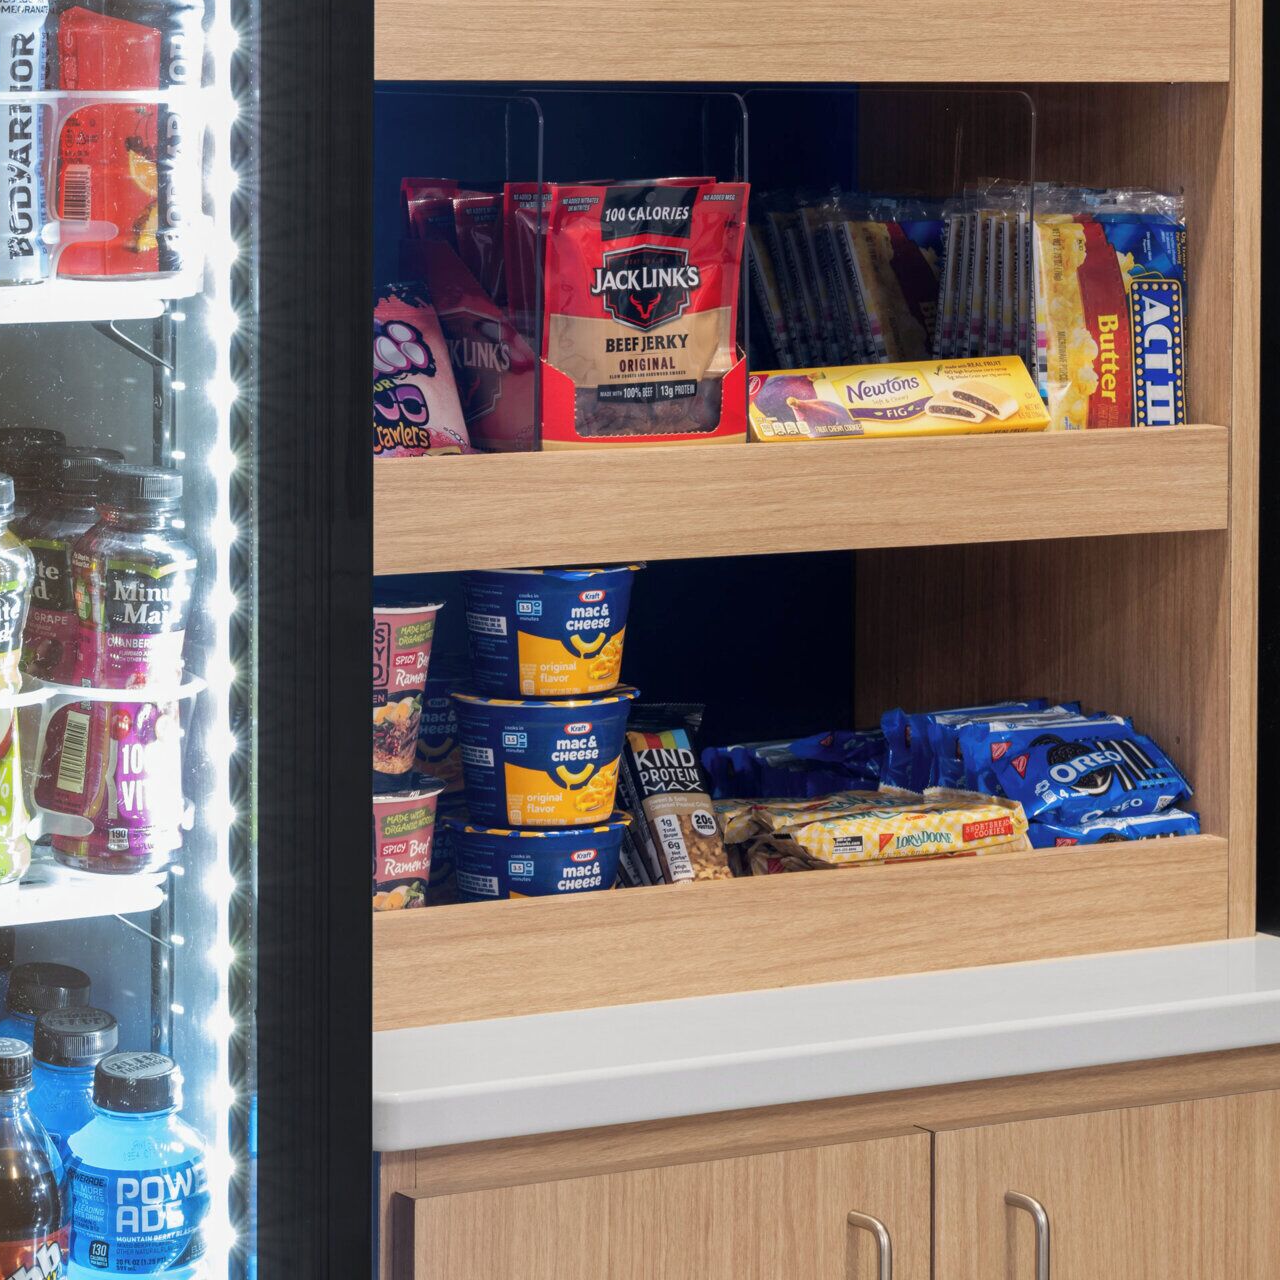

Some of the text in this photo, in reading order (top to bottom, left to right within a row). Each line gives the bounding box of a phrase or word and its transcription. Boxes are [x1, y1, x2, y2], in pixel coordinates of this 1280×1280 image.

[605, 206, 690, 222] 100 CALORIES
[591, 266, 699, 294] JACK LINK'S
[1142, 295, 1174, 374] ACT
[605, 333, 689, 353] BEEF JERKY
[619, 356, 676, 373] ORIGINAL
[1098, 314, 1120, 403] Butter
[623, 386, 653, 398] 100% BEEF
[660, 385, 674, 398] 13g
[846, 376, 920, 403] Newtons
[886, 408, 908, 418] FIG
[584, 591, 601, 600] Kraft
[519, 603, 531, 612] 3.5
[571, 606, 599, 619] mac
[34, 611, 69, 625] GRAPE
[395, 654, 416, 665] SPICY
[540, 661, 577, 674] original
[540, 673, 570, 683] flavor
[570, 724, 587, 733] Kraft
[556, 738, 587, 750] mac
[634, 749, 695, 771] KIND
[1050, 750, 1124, 783] OREO
[640, 768, 700, 785] PROTEIN
[643, 781, 703, 795] MAX
[527, 792, 563, 804] original
[527, 803, 556, 813] flavor
[922, 830, 954, 846] DOONE
[973, 826, 1007, 839] COOKIES
[382, 835, 431, 857] SPICY Beef
[576, 851, 592, 860] Kraft
[563, 866, 591, 878] mac
[116, 1199, 185, 1233] ADE
[117, 1232, 175, 1243] MOUNTAIN BERRY
[92, 1242, 107, 1257] 130
